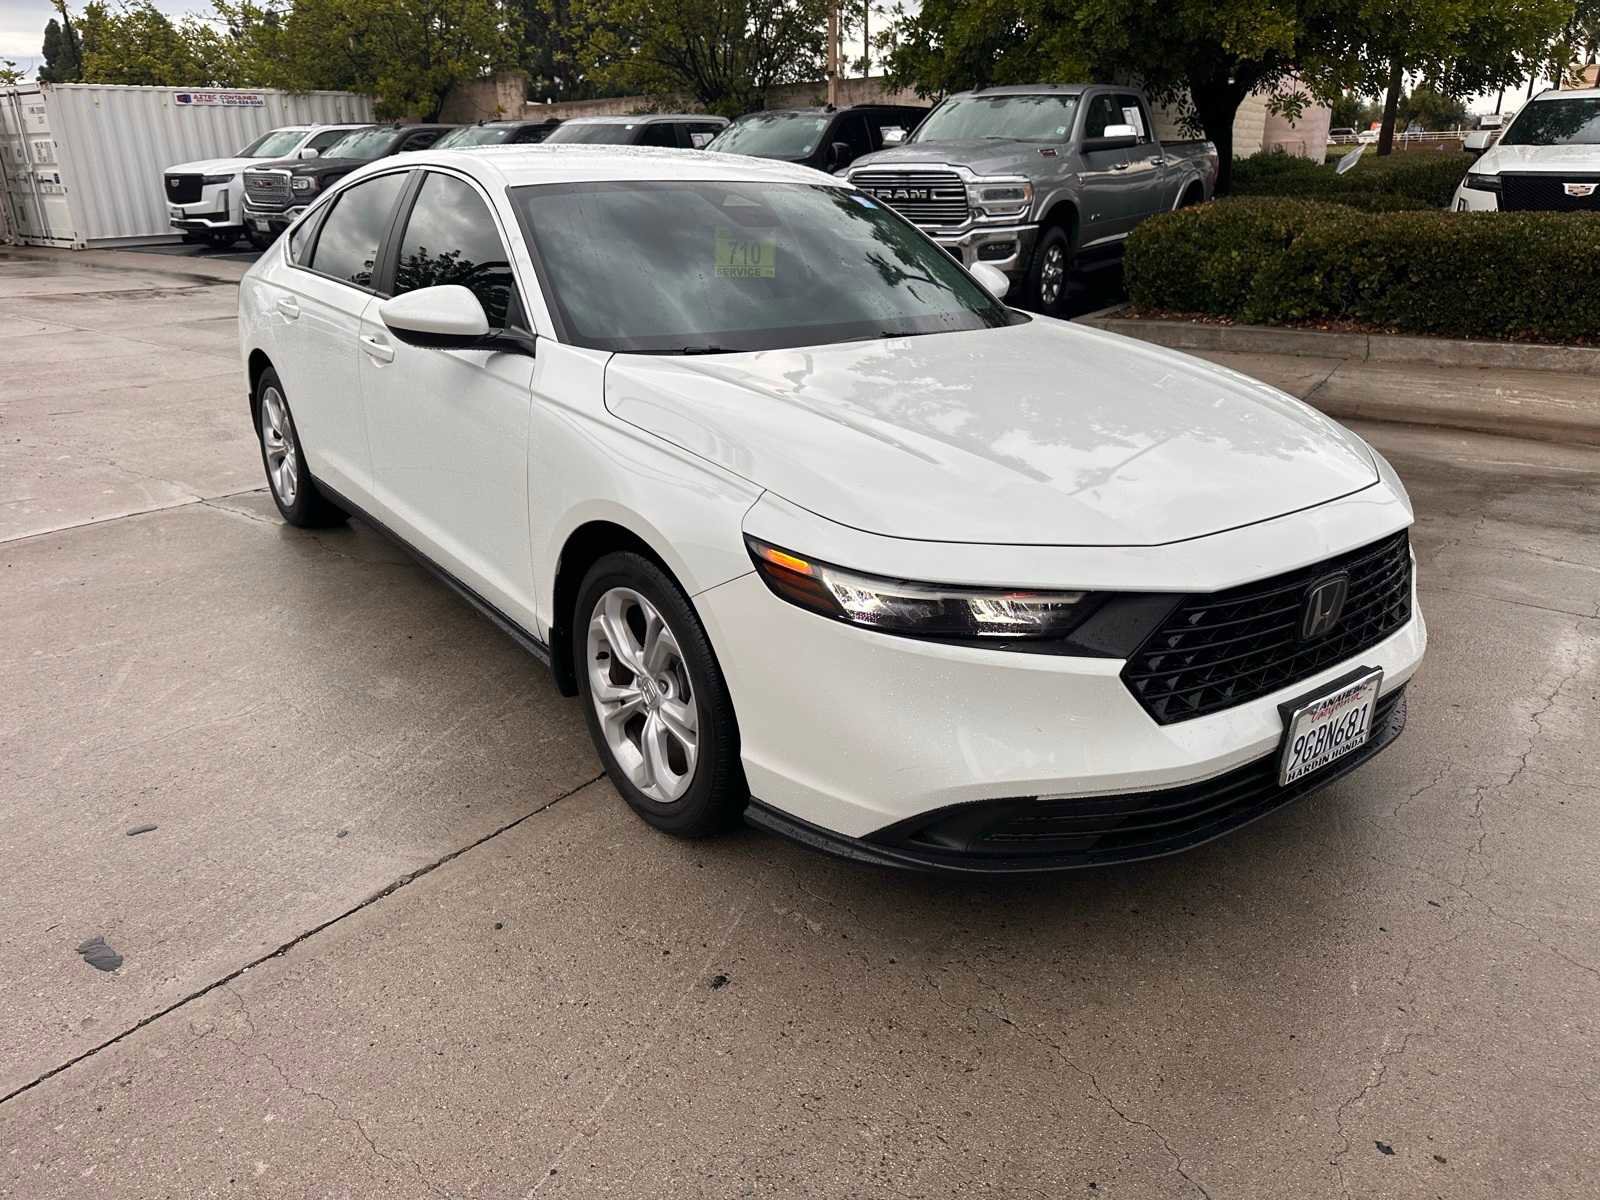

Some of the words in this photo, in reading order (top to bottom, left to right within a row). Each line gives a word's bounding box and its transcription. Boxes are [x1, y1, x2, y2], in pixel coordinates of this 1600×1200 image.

[874, 188, 927, 199] RAM
[728, 241, 761, 265] 710
[717, 267, 761, 278] SERVICE
[1289, 703, 1368, 771] 9GBN681
[1287, 754, 1330, 782] HARDIN
[1332, 737, 1364, 760] HONDA
